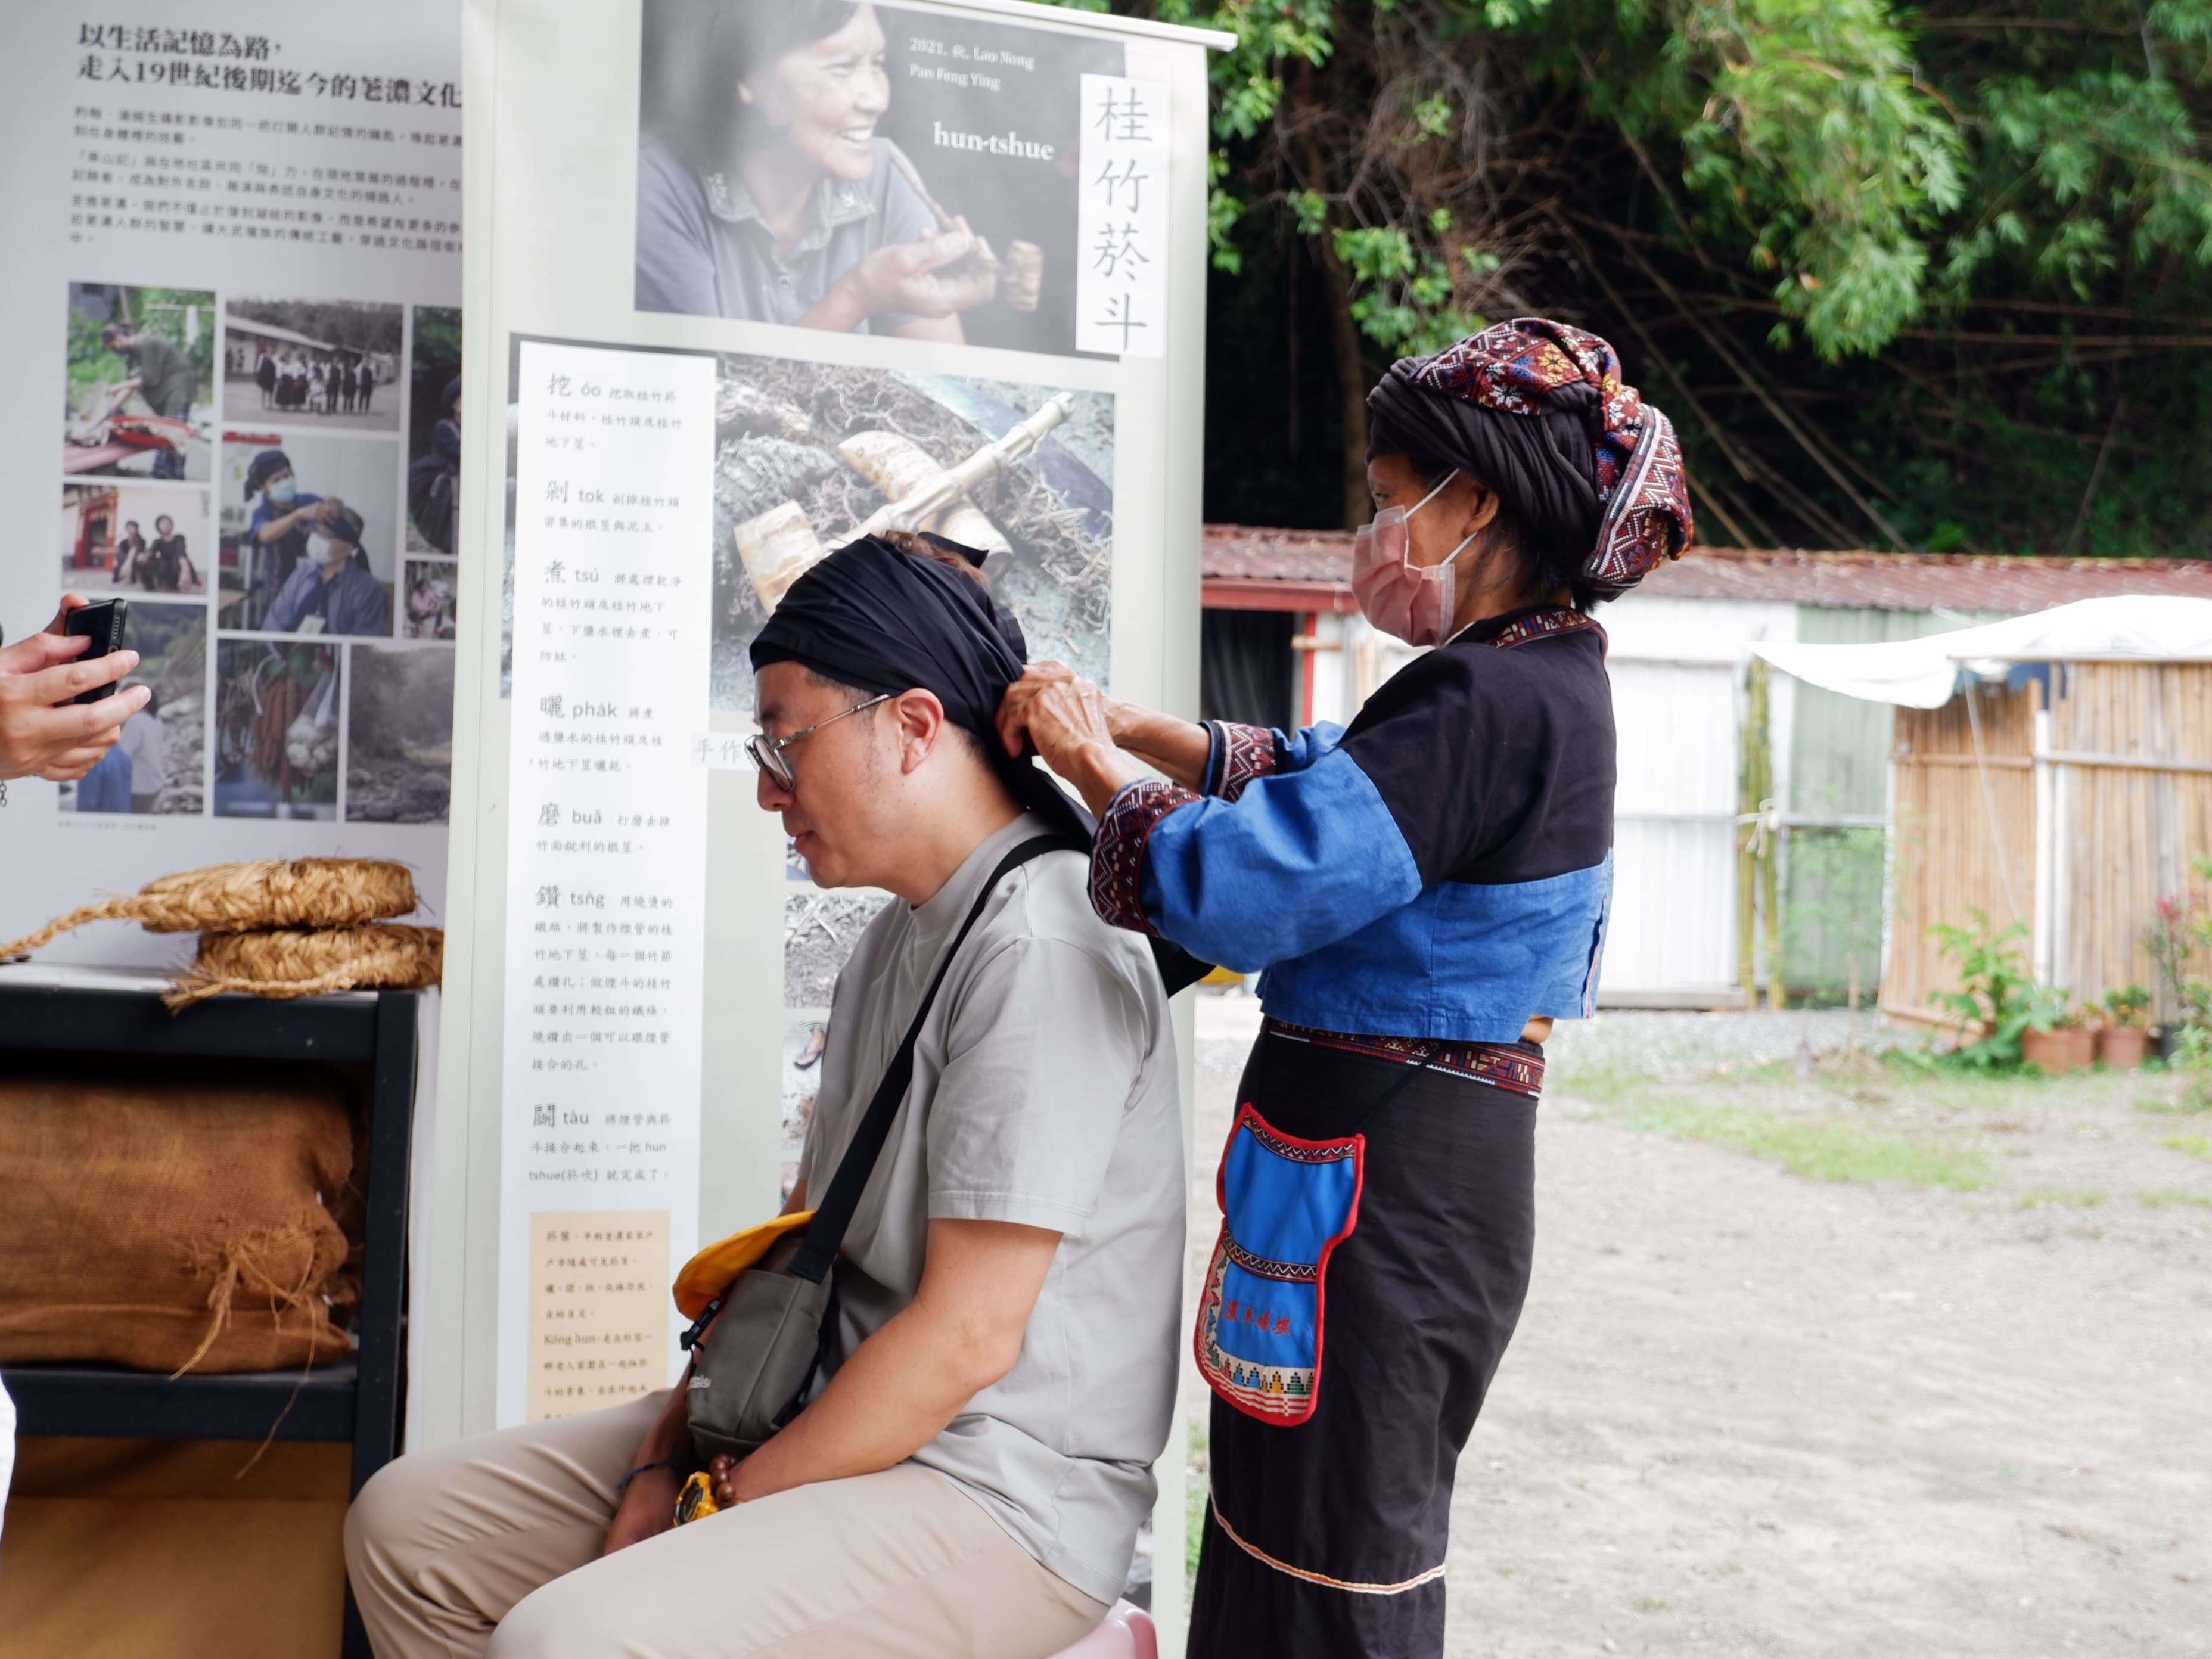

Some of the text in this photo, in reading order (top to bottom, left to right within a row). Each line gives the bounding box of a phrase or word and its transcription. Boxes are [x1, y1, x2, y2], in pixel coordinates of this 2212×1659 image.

[79, 22, 283, 61] 以生活記憶為路，
[973, 46, 998, 62] Lao
[999, 51, 1035, 72] Nong
[910, 63, 1002, 92] Pan Feng Ying
[1094, 86, 1152, 351] 桂竹菸斗
[547, 372, 573, 398] 挖
[578, 487, 605, 504] tok
[544, 559, 566, 585] 煮
[540, 693, 565, 719] 曬
[538, 802, 561, 827] 磨
[535, 883, 561, 909] 鑽
